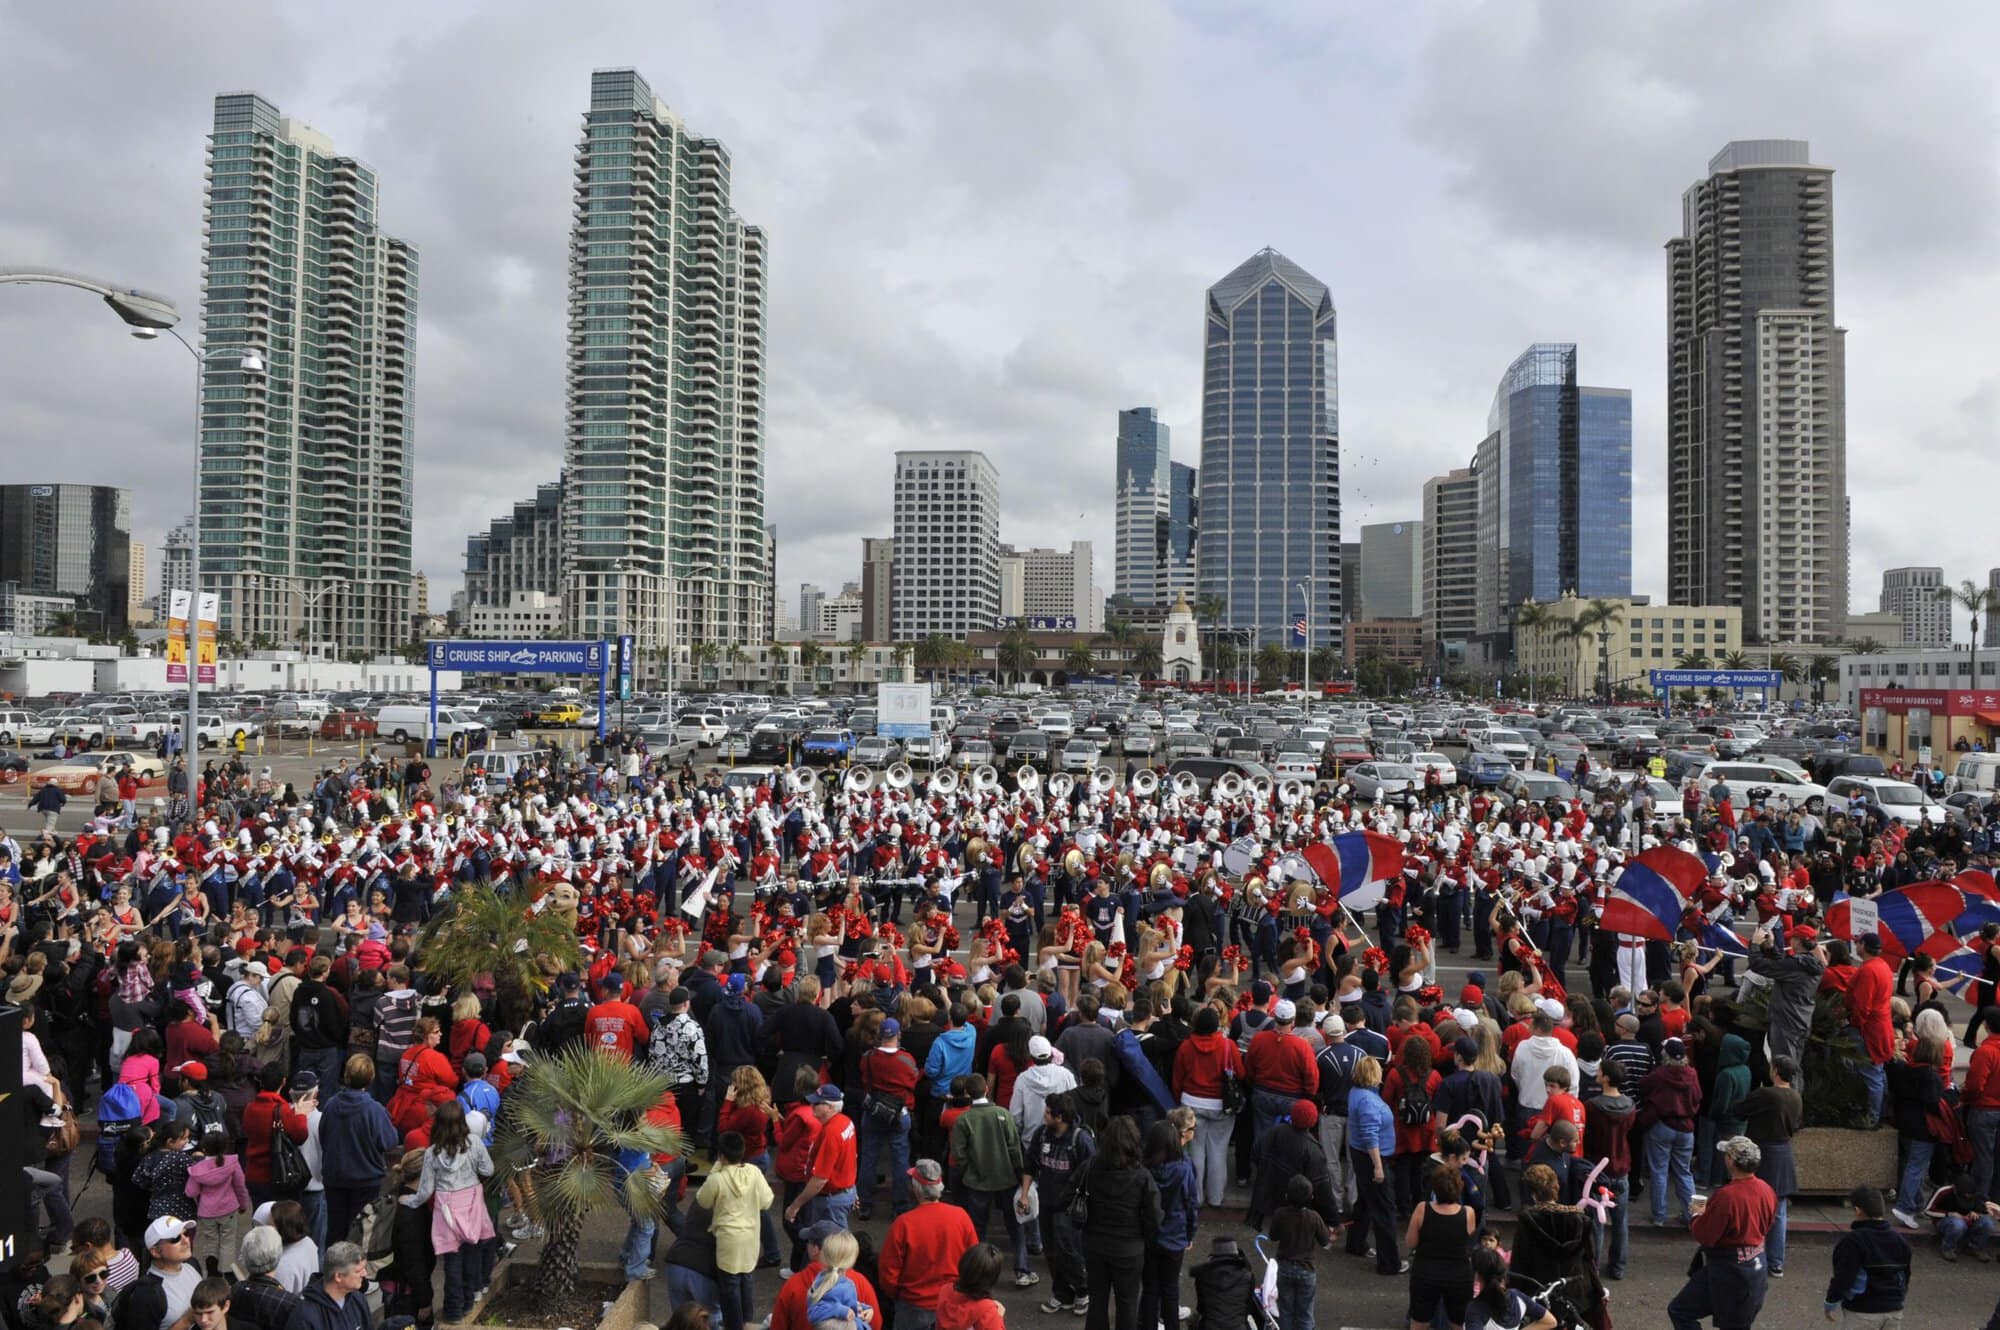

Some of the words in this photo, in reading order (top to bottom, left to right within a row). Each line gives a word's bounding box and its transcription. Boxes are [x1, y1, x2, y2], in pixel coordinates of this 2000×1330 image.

[997, 617, 1046, 628] Sata
[1056, 617, 1073, 628] Fe
[435, 646, 444, 658] 5
[589, 647, 598, 660] 5
[623, 638, 630, 661] 5
[449, 650, 485, 662] CRUISE
[487, 650, 510, 662] SHIP
[539, 650, 584, 663] PARKING
[1664, 674, 1693, 682] CRUISE
[1694, 674, 1712, 682] SHIP
[623, 679, 629, 696] P
[1904, 697, 1943, 705] INFORMATION
